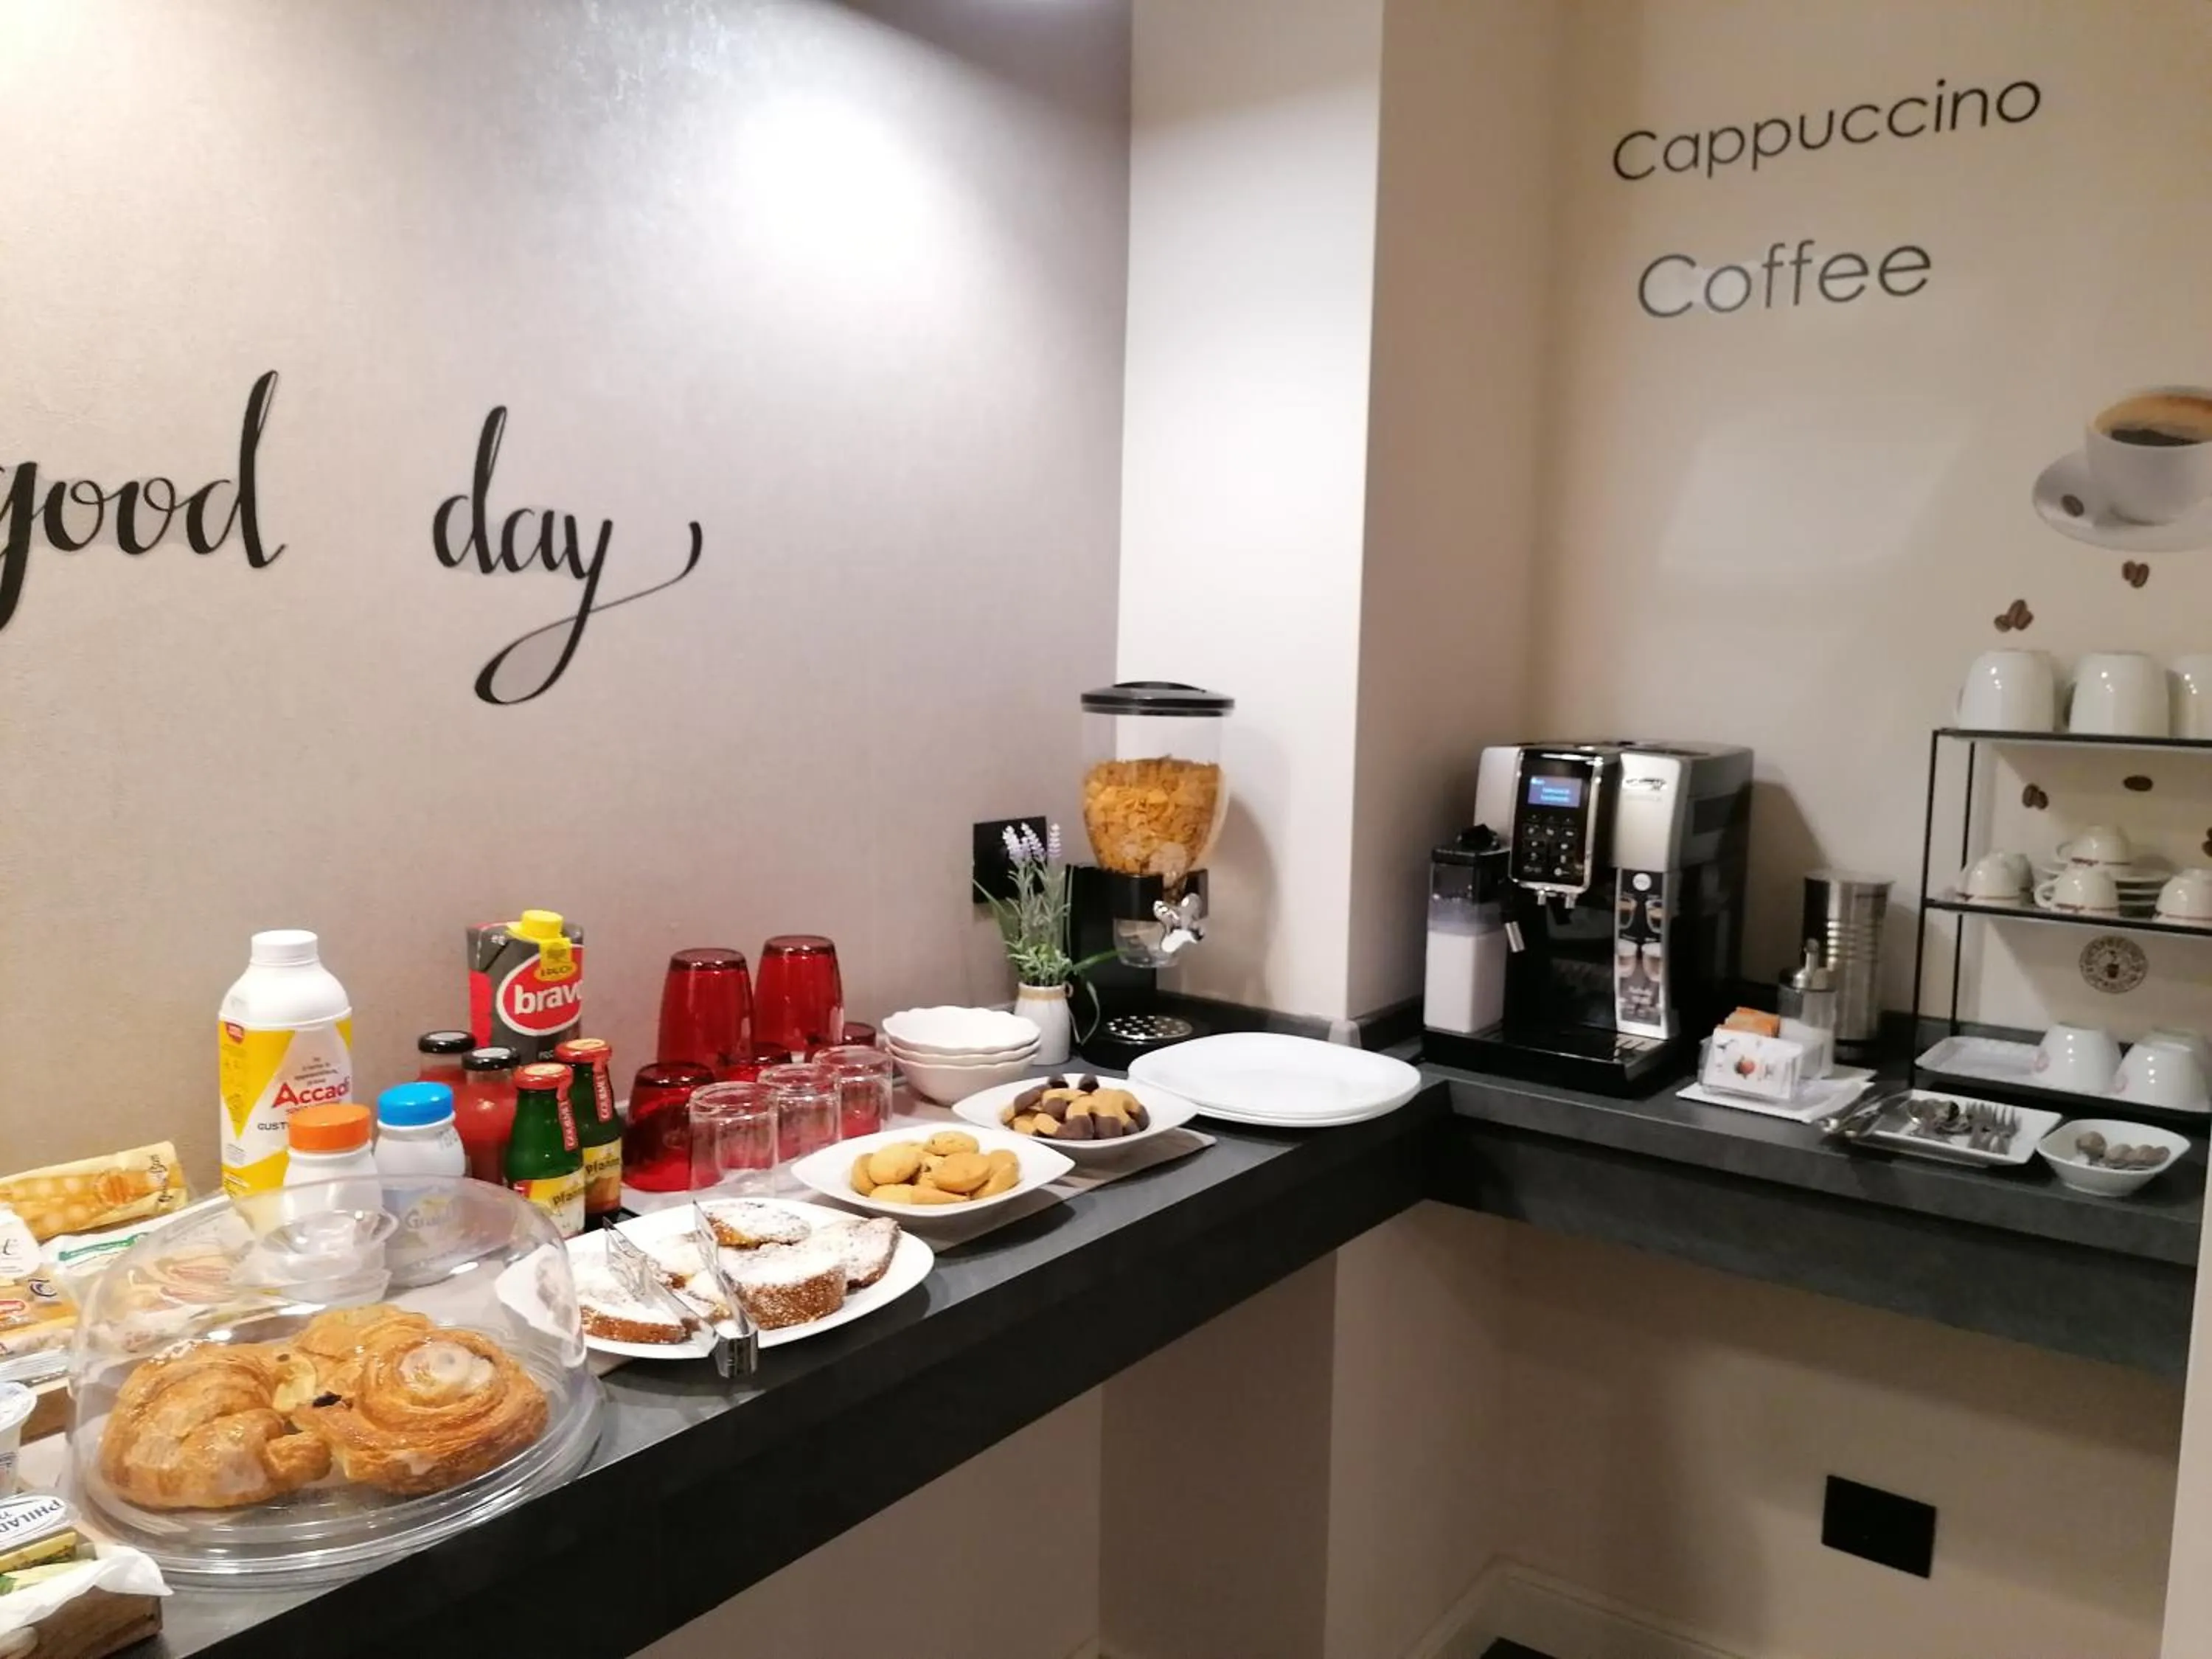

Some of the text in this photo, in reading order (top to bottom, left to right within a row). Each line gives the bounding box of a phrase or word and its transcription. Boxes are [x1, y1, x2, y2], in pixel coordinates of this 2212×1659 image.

[1613, 78, 2042, 181] Cappuccino
[1638, 240, 1932, 318] Coffee
[433, 406, 703, 706] day
[257, 1121, 291, 1130] GUST
